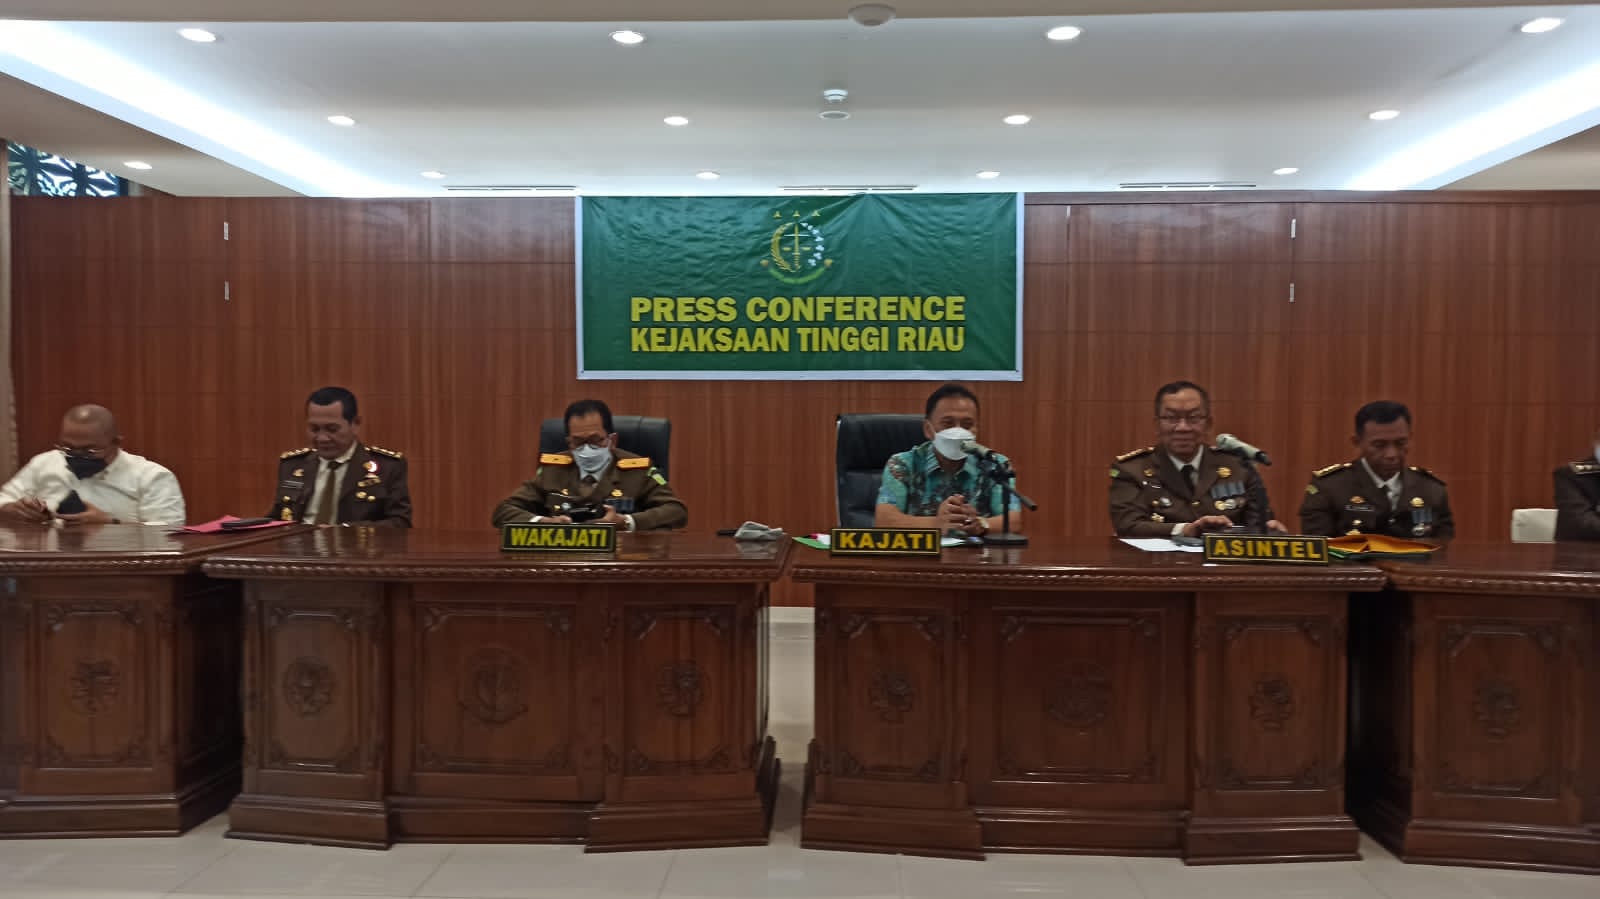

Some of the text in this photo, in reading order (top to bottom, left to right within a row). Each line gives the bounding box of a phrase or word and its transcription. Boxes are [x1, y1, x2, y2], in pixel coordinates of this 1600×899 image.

[631, 296, 966, 322] PRESS CONFERENCE
[630, 326, 966, 353] KEJAKSAAN TINGGI RIAU
[511, 528, 608, 547] WAKAJATI
[839, 532, 934, 550] KAJATI
[1213, 539, 1321, 559] ASINTEL
